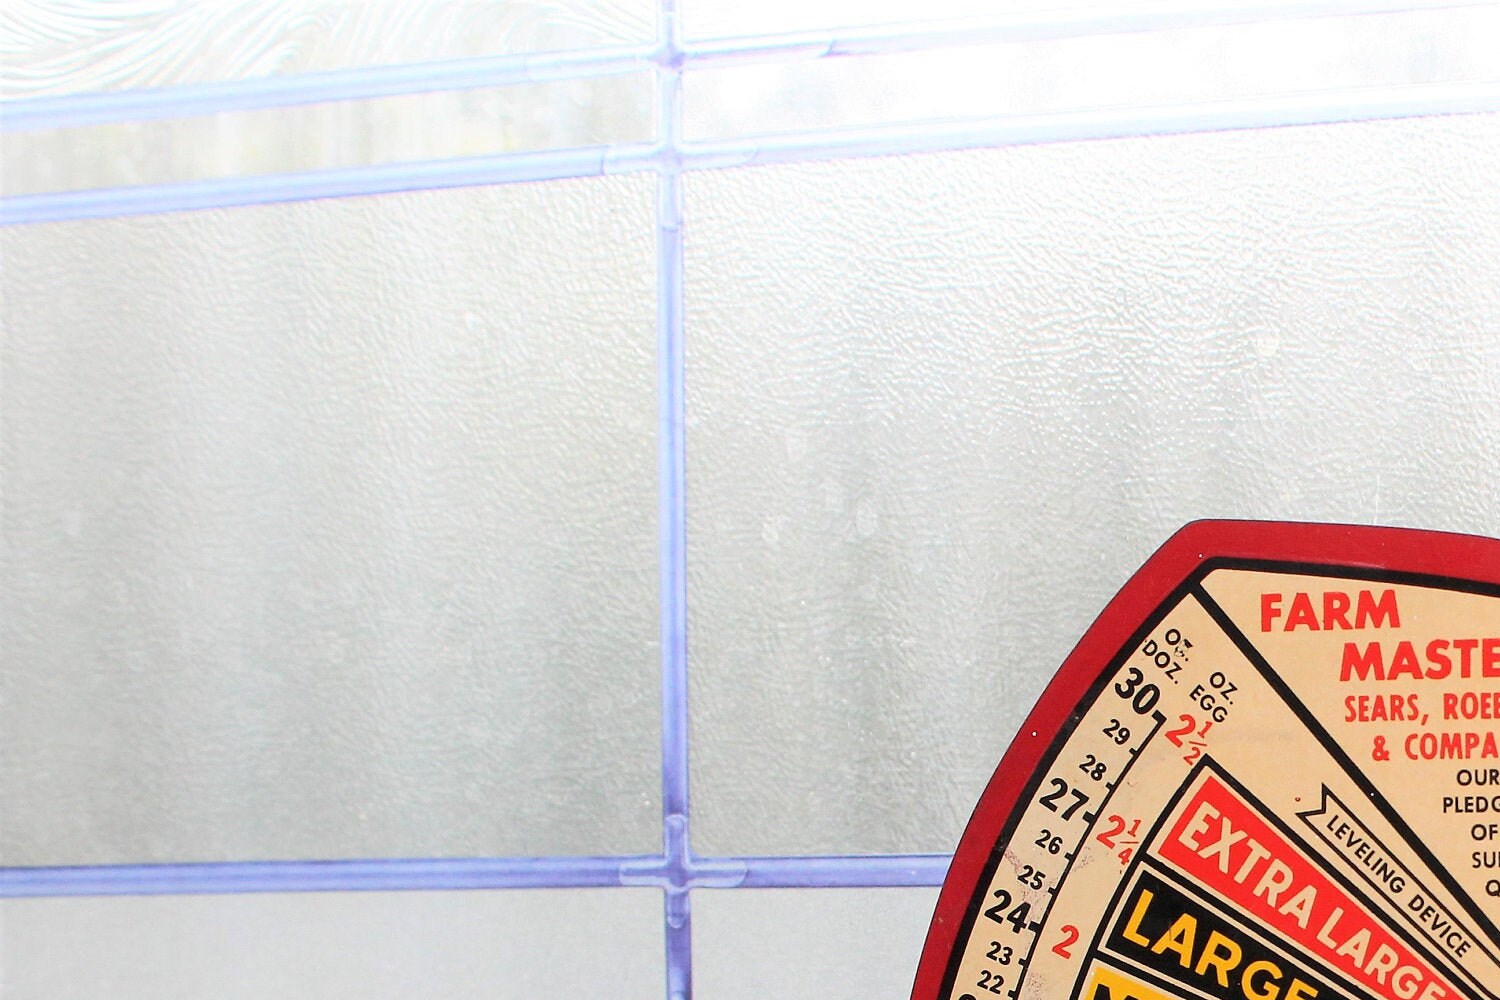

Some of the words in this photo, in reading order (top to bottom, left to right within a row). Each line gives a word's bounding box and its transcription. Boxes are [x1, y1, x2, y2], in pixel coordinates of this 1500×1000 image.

[1260, 588, 1400, 633] FARM
[1142, 639, 1182, 684] DOZ.
[1114, 667, 1161, 715] 30
[1189, 684, 1228, 723] EGG
[1209, 671, 1238, 705] OZ.
[1344, 695, 1429, 725] SEARS,
[1102, 718, 1131, 745] 29
[1372, 735, 1390, 761] &
[1078, 754, 1107, 781] 28
[1456, 768, 1500, 786] OUR
[1038, 777, 1090, 822] 27
[1034, 828, 1063, 855] 26
[1470, 823, 1499, 841] OF
[1017, 865, 1046, 890] 25
[1177, 800, 1319, 930] EXTRA
[1326, 814, 1406, 894] LEVELING
[1407, 894, 1472, 958] DEVICE
[984, 889, 1032, 934] 24
[986, 941, 1013, 966] 23
[1051, 924, 1080, 960] 2
[976, 969, 1004, 995] 22
